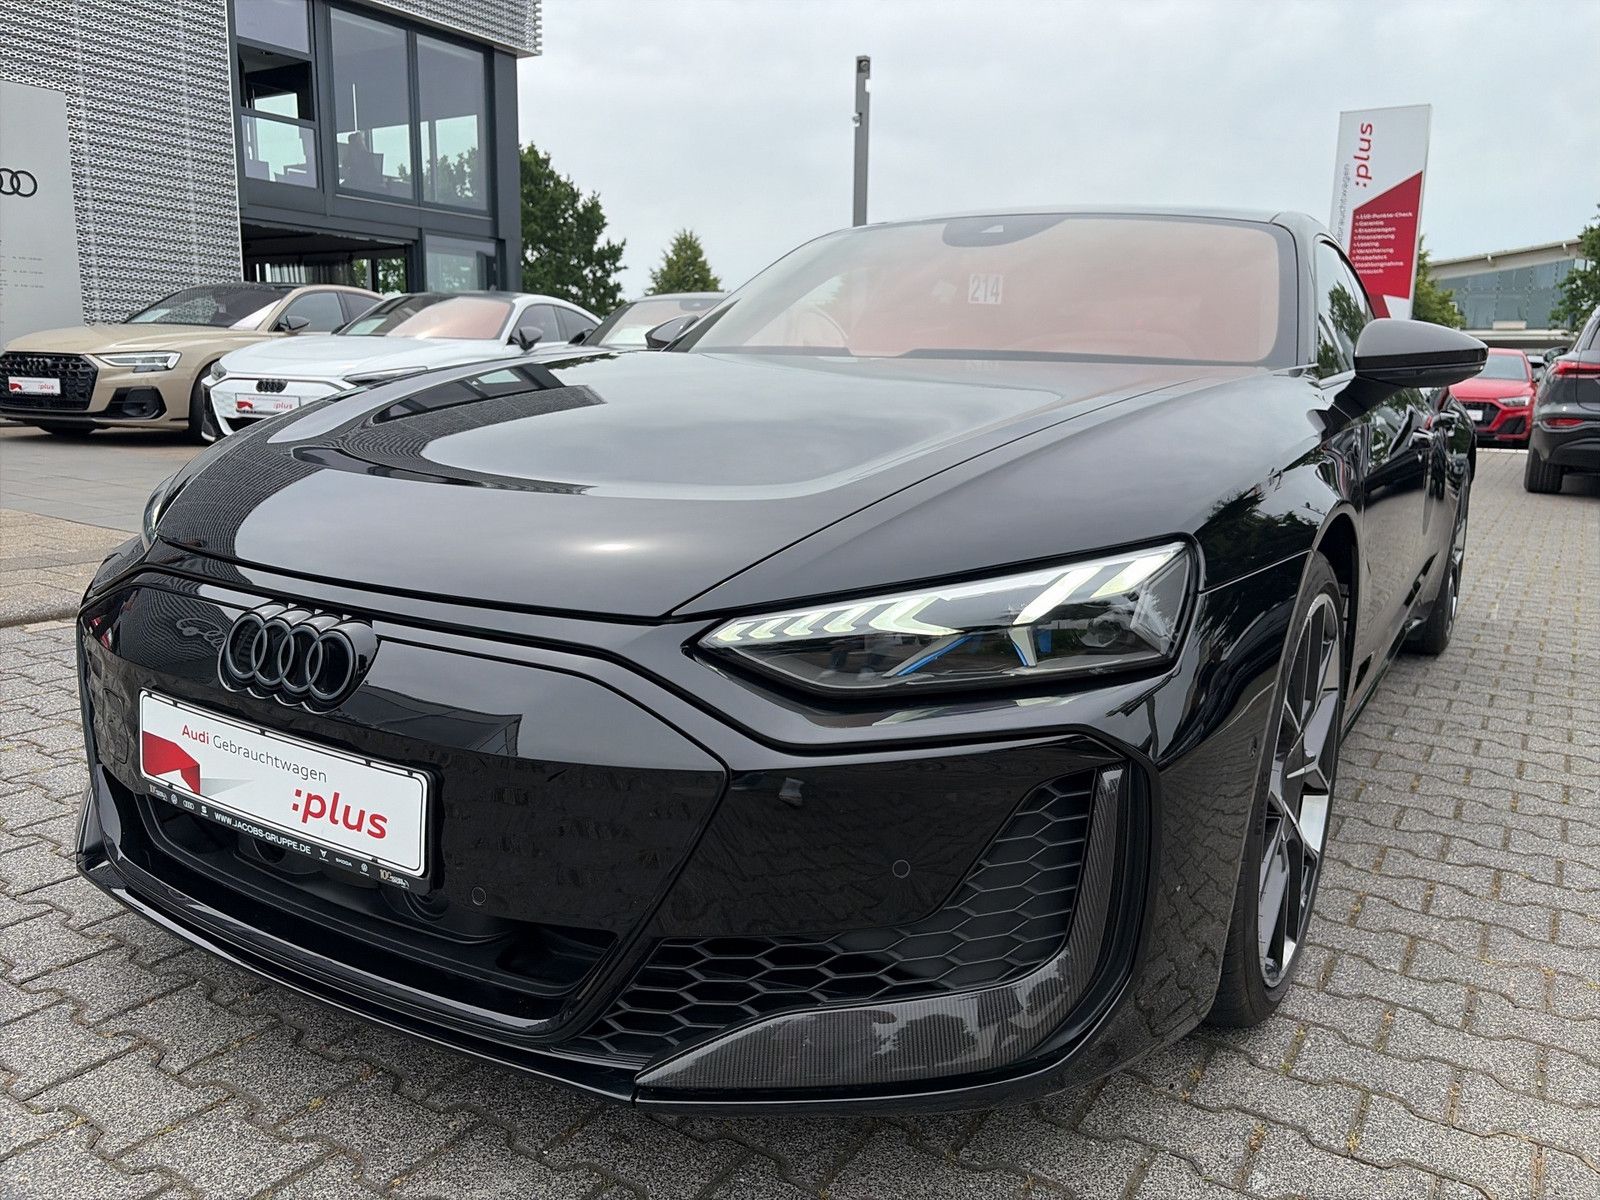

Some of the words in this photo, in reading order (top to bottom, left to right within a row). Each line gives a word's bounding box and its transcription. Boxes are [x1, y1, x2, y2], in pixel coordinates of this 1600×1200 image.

[1353, 123, 1373, 188] :plus
[1337, 163, 1350, 243] ebrauchtwagen
[970, 274, 1000, 302] 214
[182, 724, 209, 745] Audi
[213, 735, 327, 783] Gebrauchtwagen
[214, 812, 312, 855] WWW.JACOBS-GRUPPE.DE
[292, 788, 388, 840] :plus
